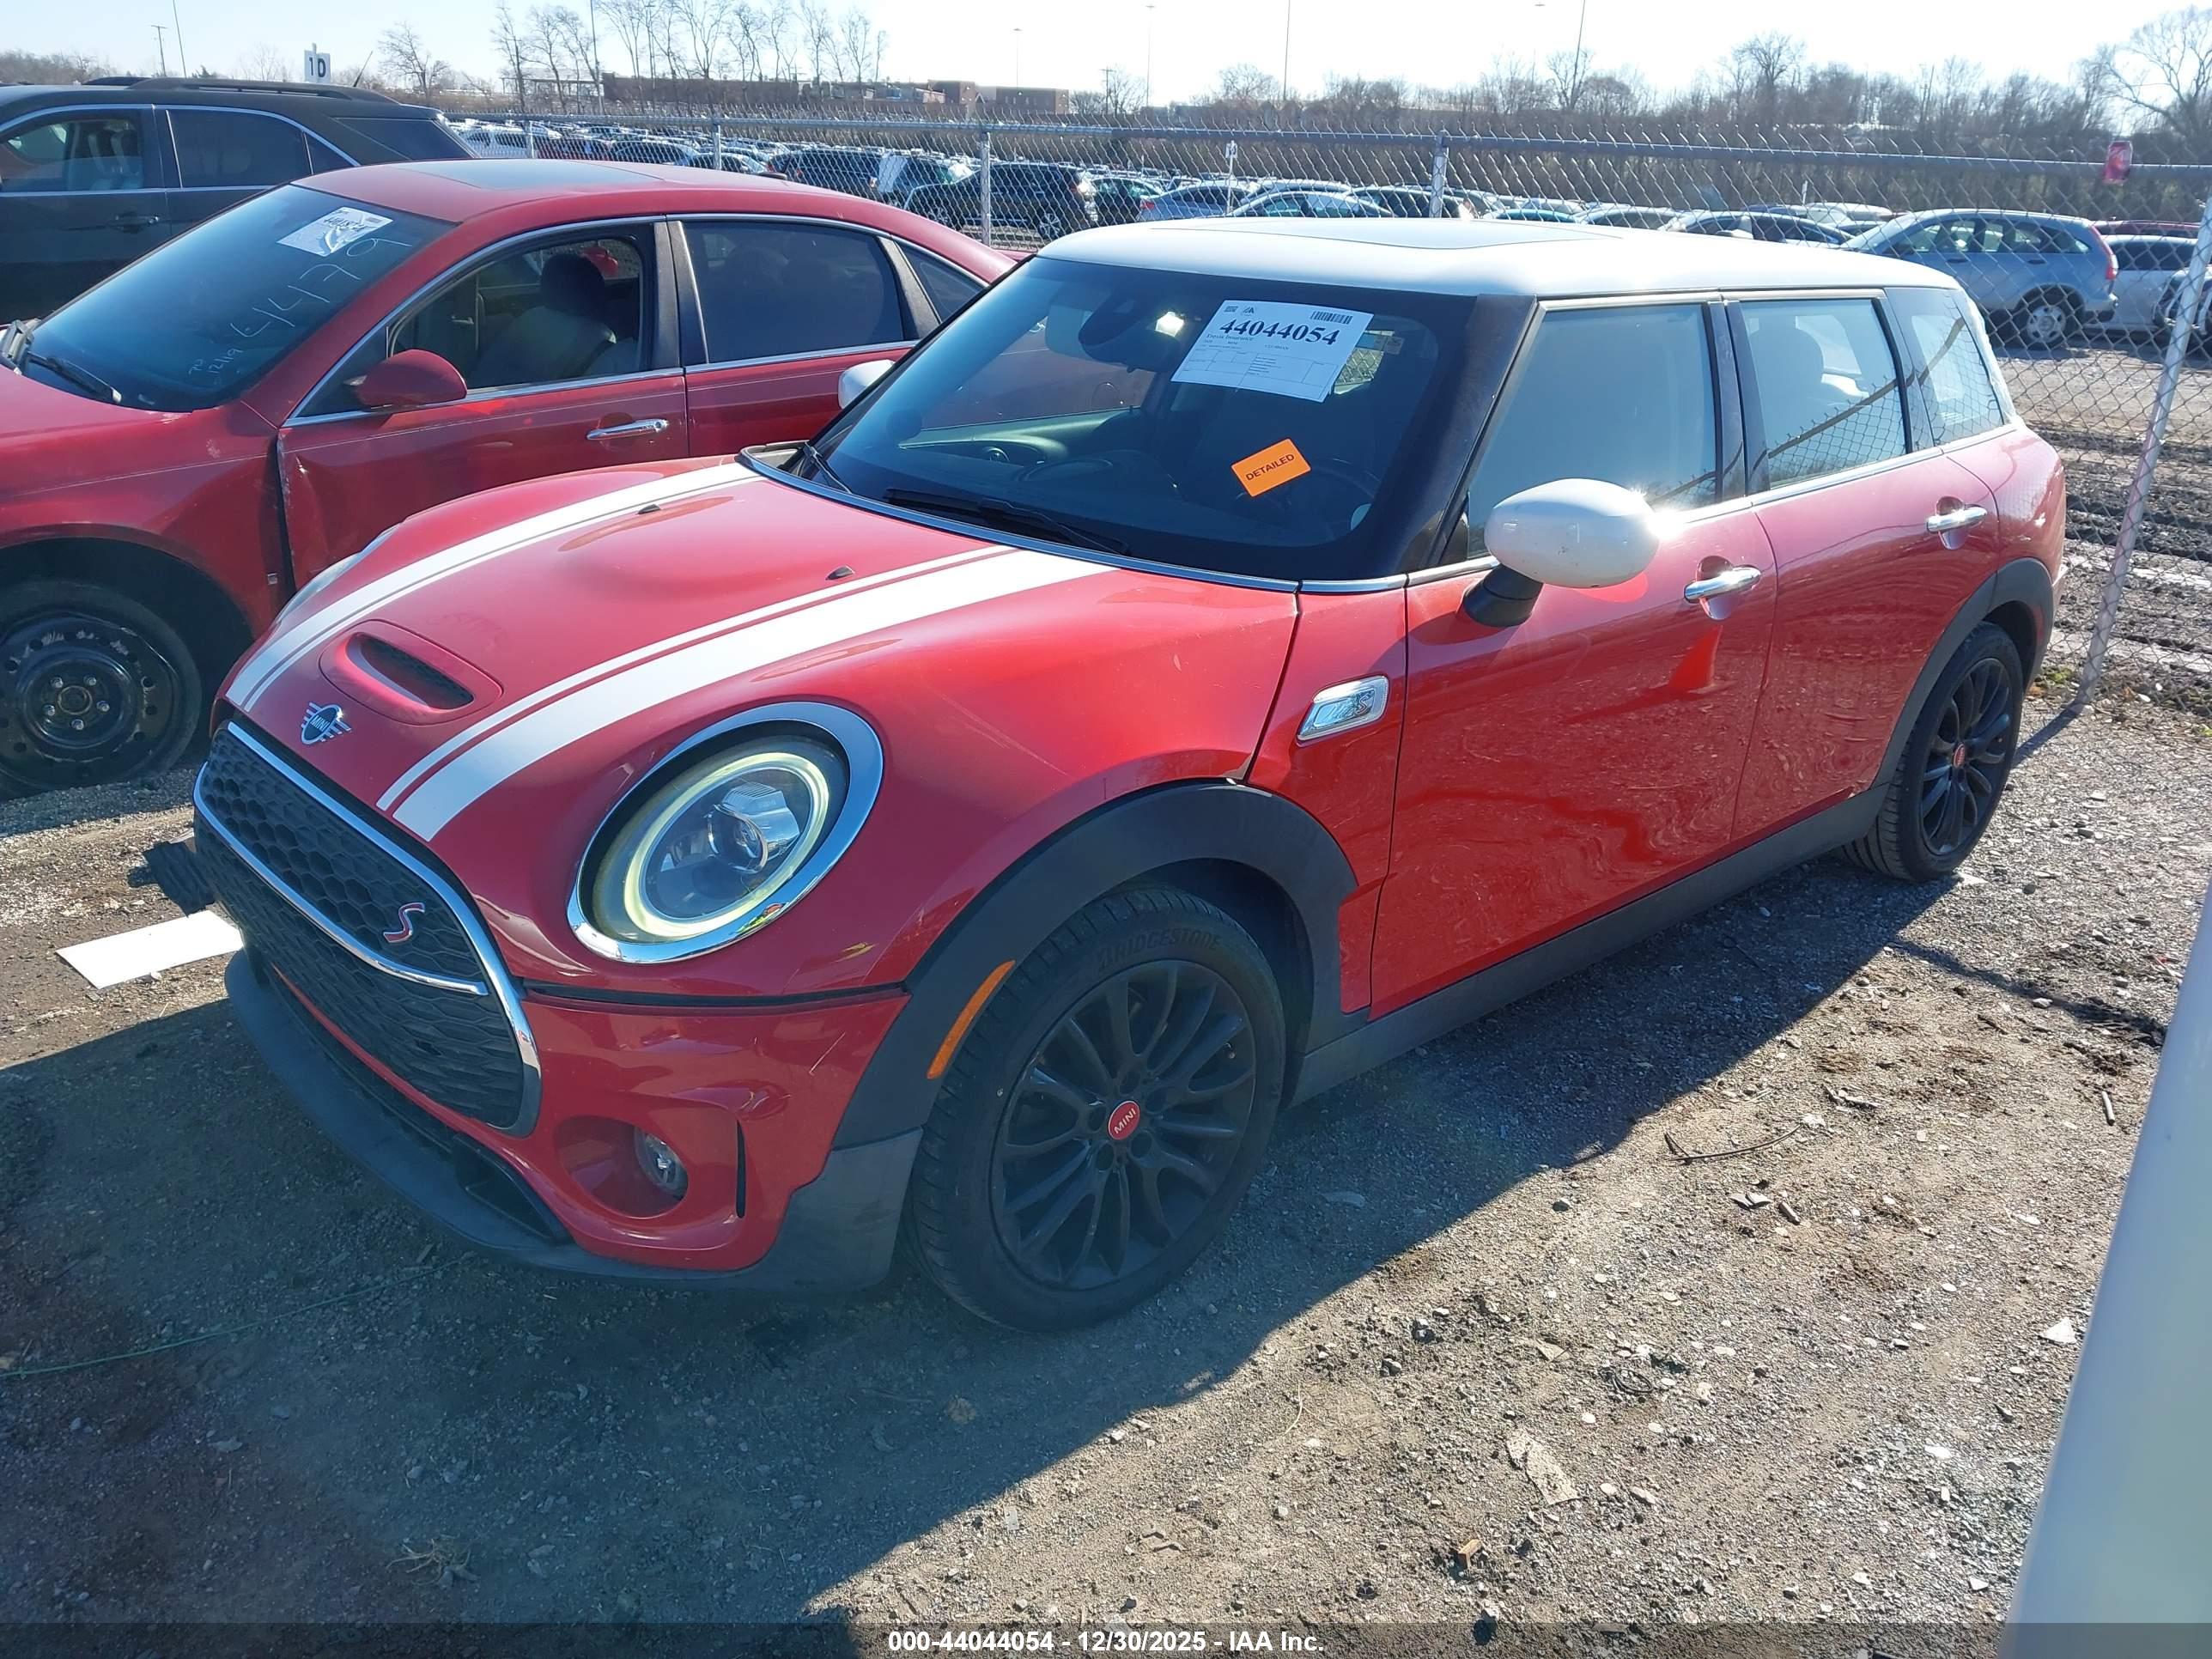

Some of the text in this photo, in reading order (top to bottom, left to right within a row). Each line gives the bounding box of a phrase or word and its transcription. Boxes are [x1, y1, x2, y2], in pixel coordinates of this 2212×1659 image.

[1219, 319, 1340, 345] 44044054
[1245, 453, 1295, 481] DETAILED
[309, 714, 331, 732] MINI
[383, 902, 425, 943] S
[1114, 1108, 1137, 1134] MINI
